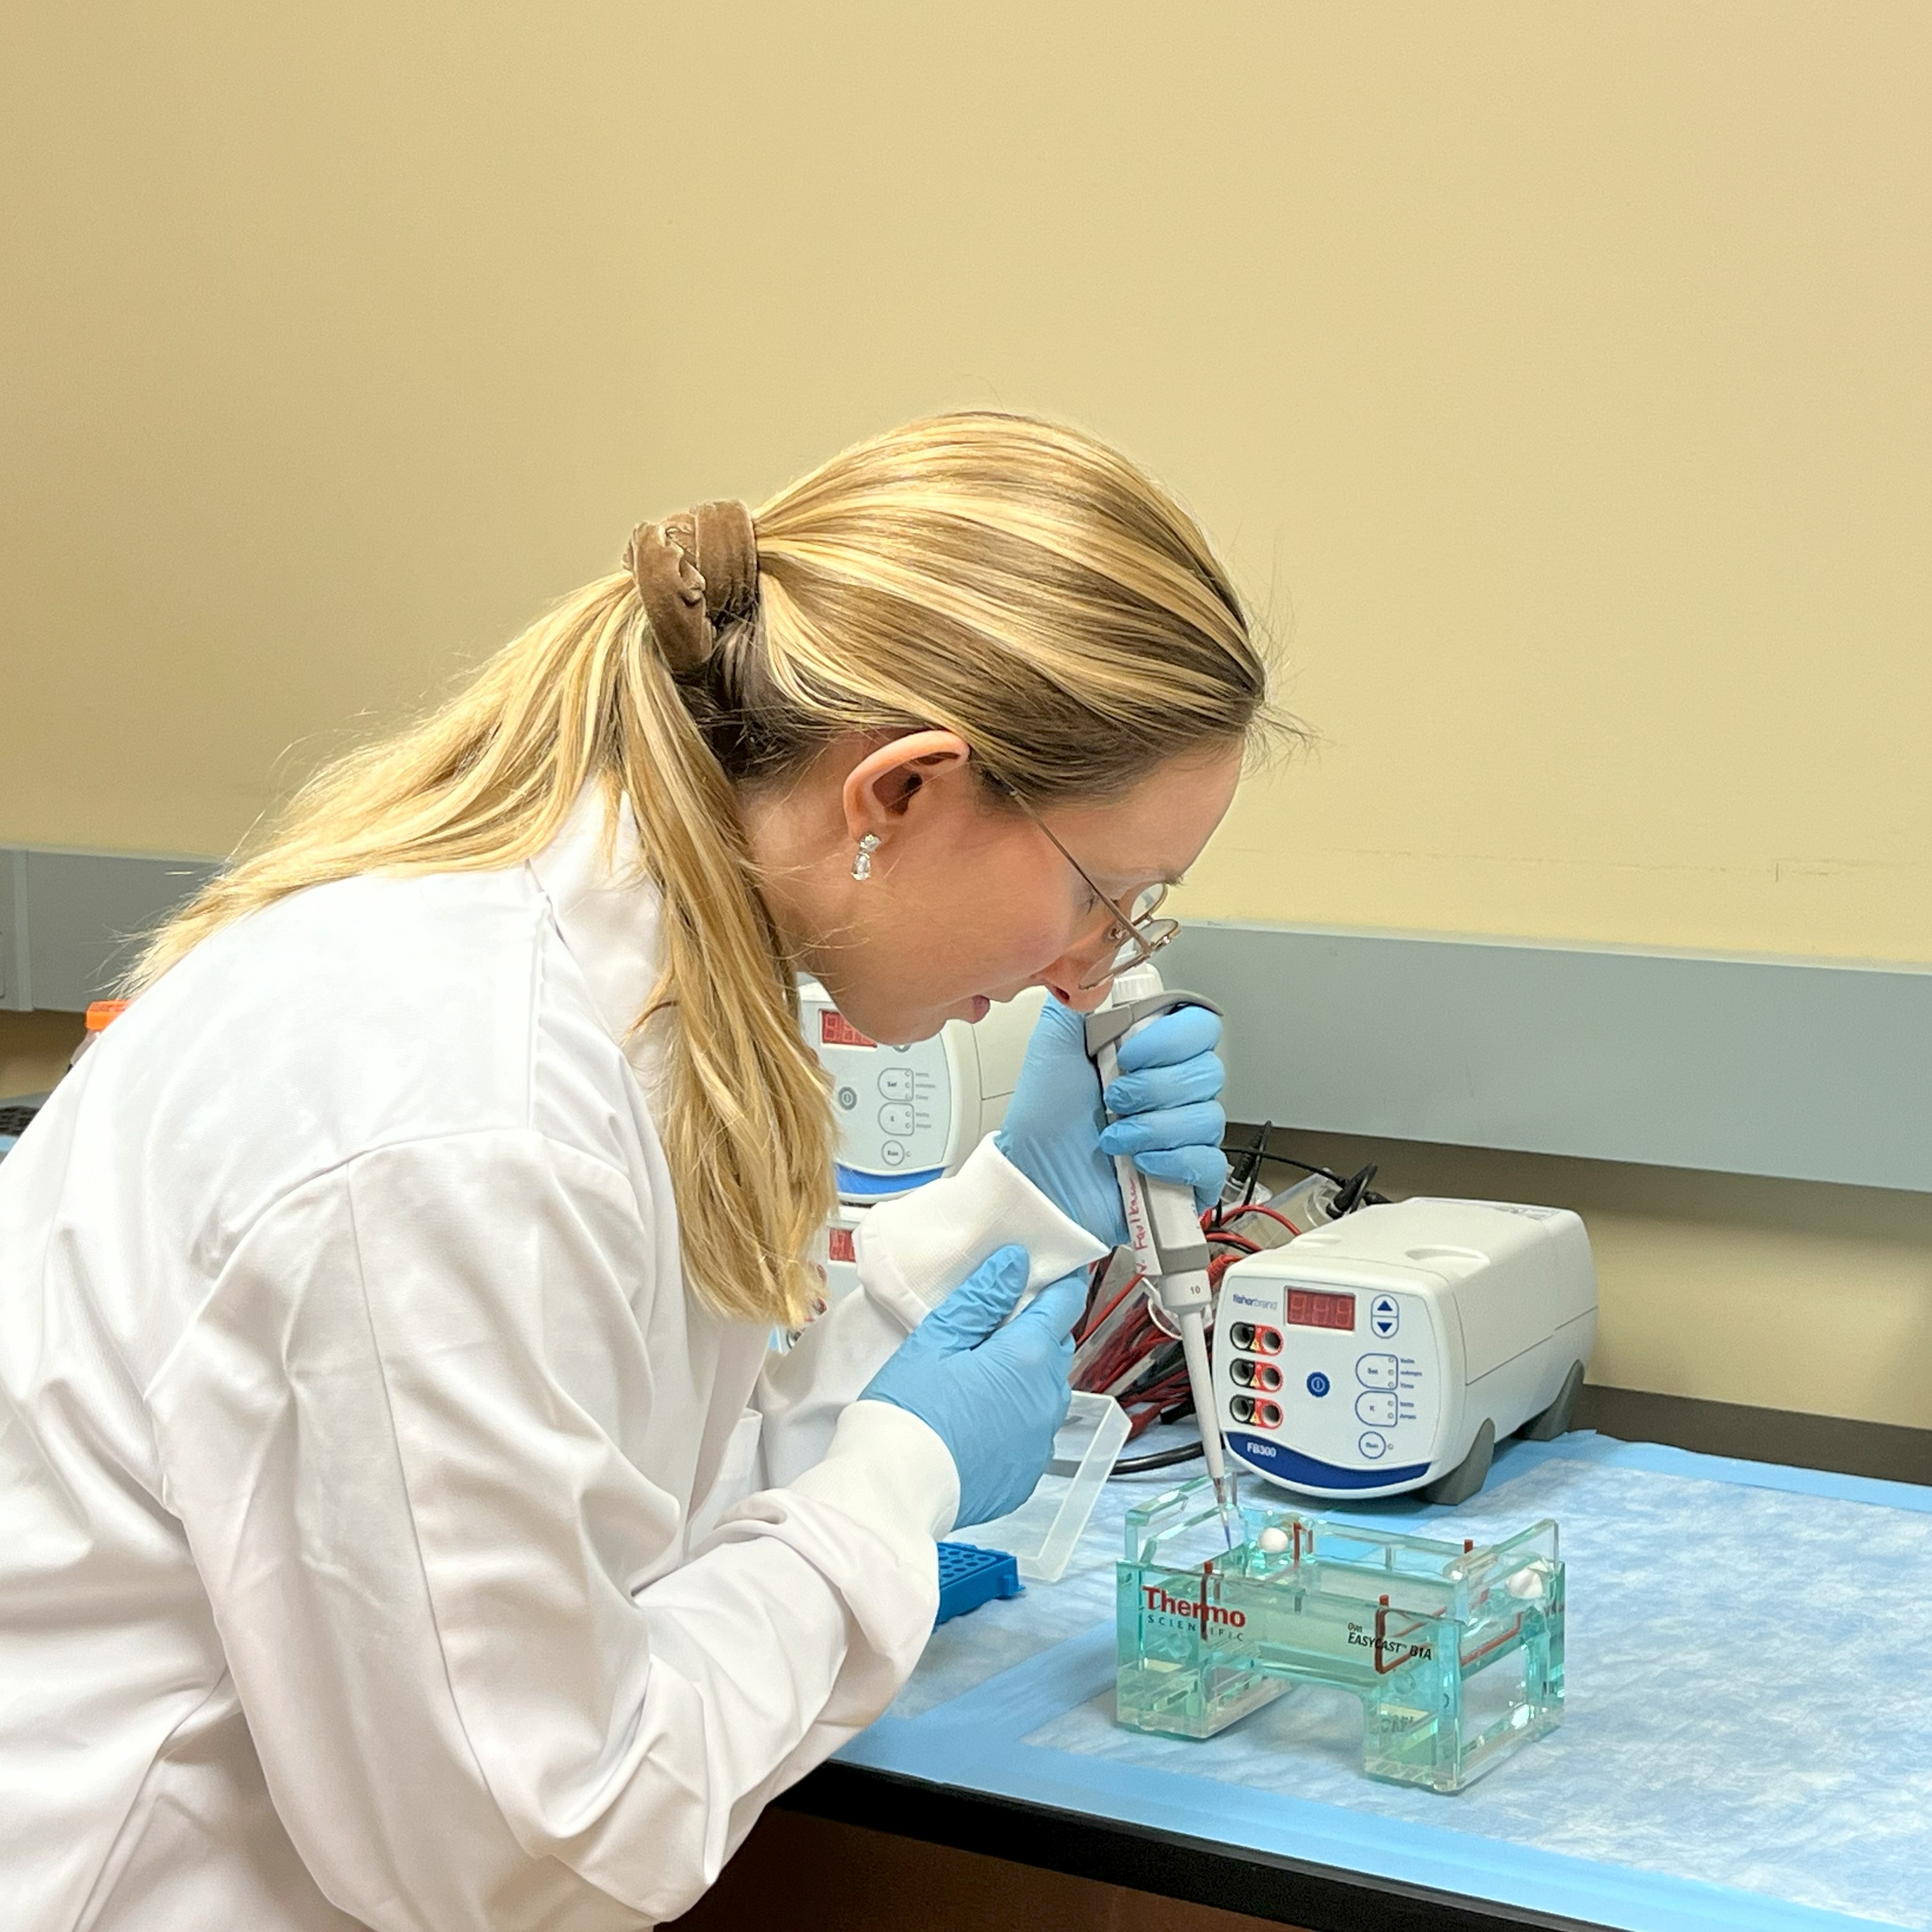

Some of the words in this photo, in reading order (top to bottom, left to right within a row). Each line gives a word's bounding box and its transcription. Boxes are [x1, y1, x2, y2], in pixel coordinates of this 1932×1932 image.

[1190, 1285, 1201, 1294] 10
[1233, 1293, 1278, 1310] fisherbrand
[1246, 1441, 1276, 1457] FB300
[1142, 1585, 1246, 1627] Thermo
[1147, 1614, 1244, 1641] SCIENIFIC
